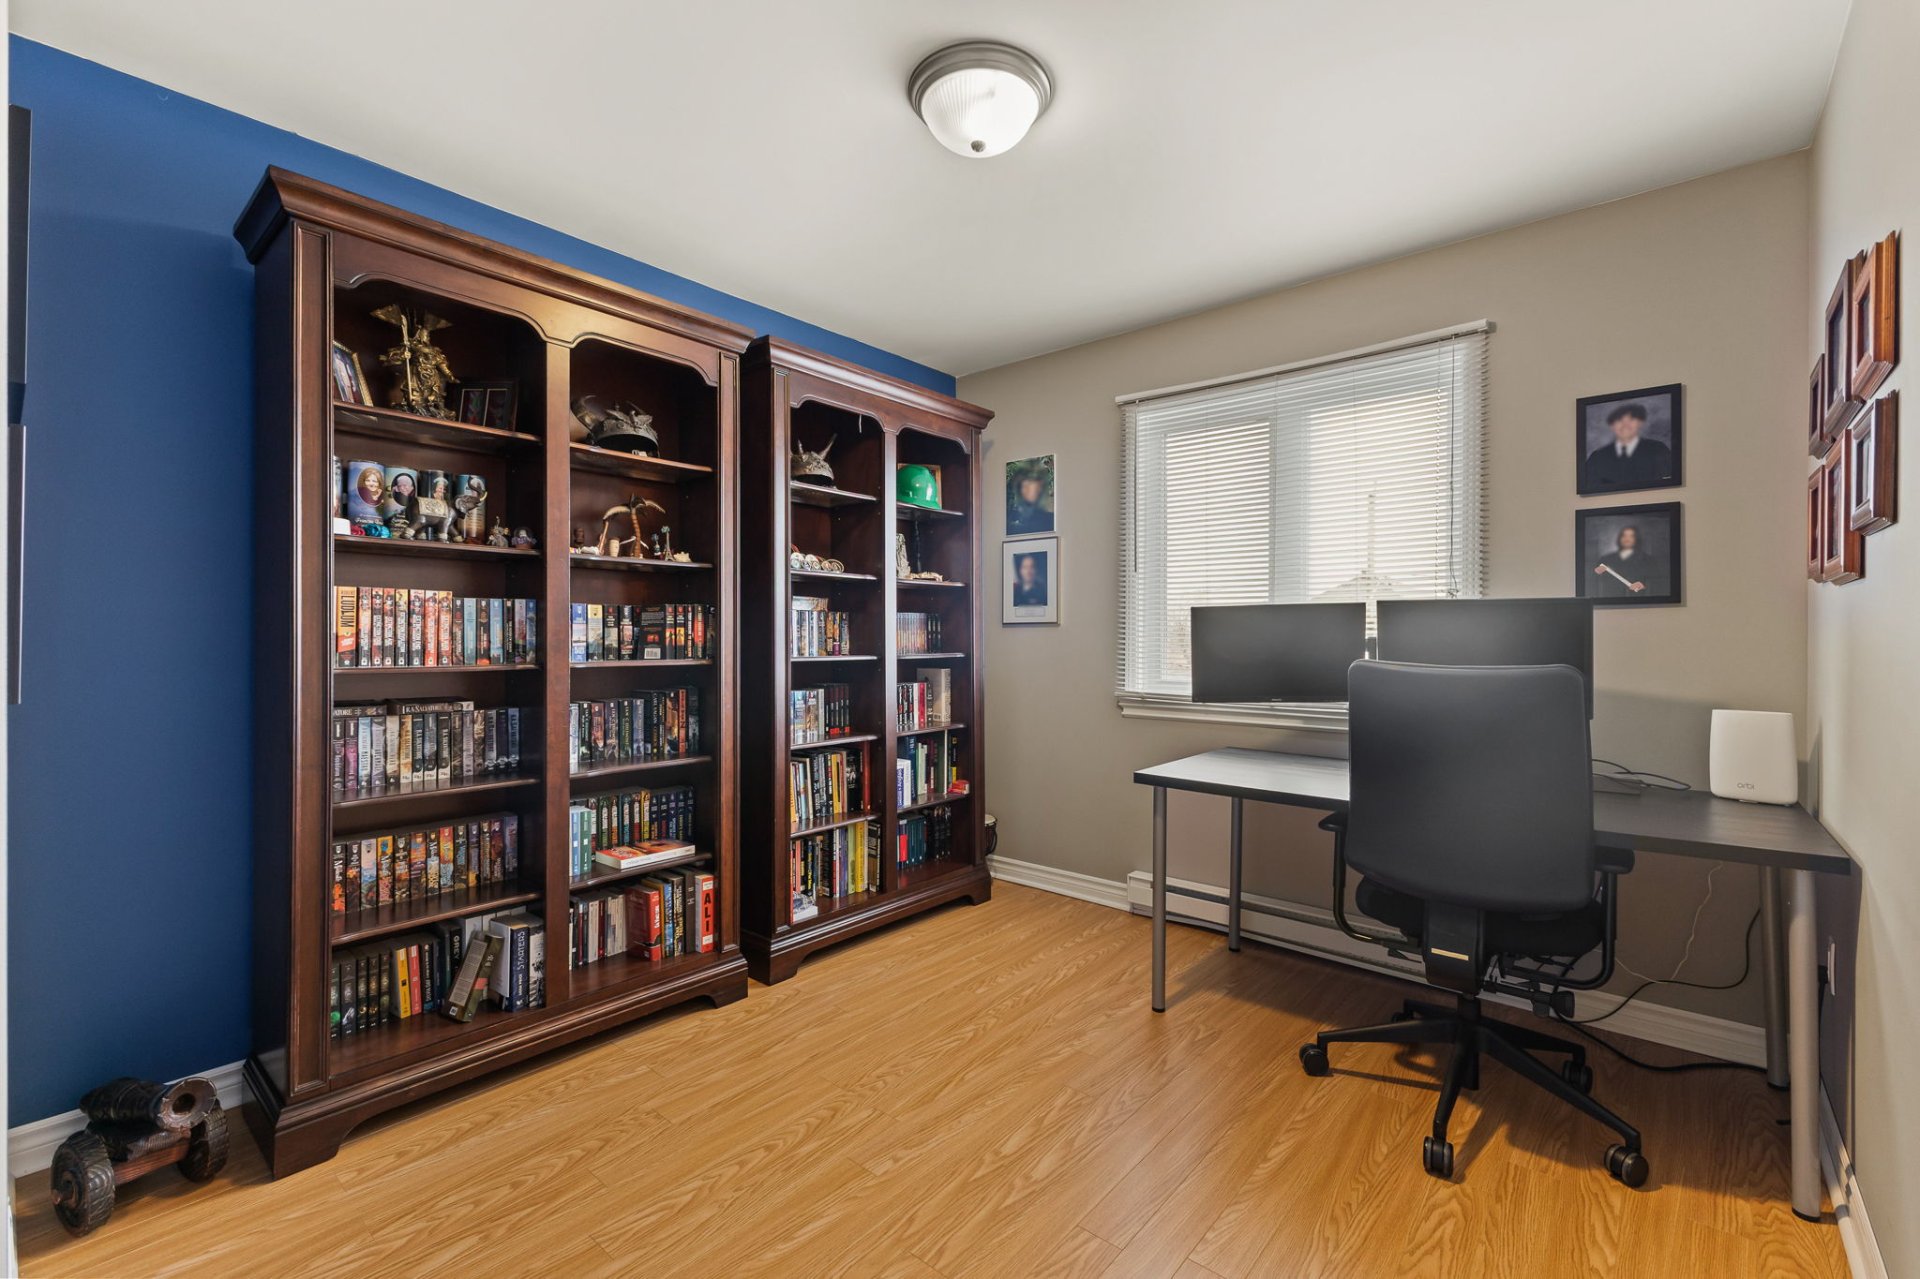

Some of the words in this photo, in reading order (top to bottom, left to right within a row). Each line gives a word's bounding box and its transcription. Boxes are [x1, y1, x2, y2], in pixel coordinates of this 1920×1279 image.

[341, 596, 355, 627] LUDLUM
[1737, 783, 1755, 792] orbi
[516, 931, 525, 970] STARTERS
